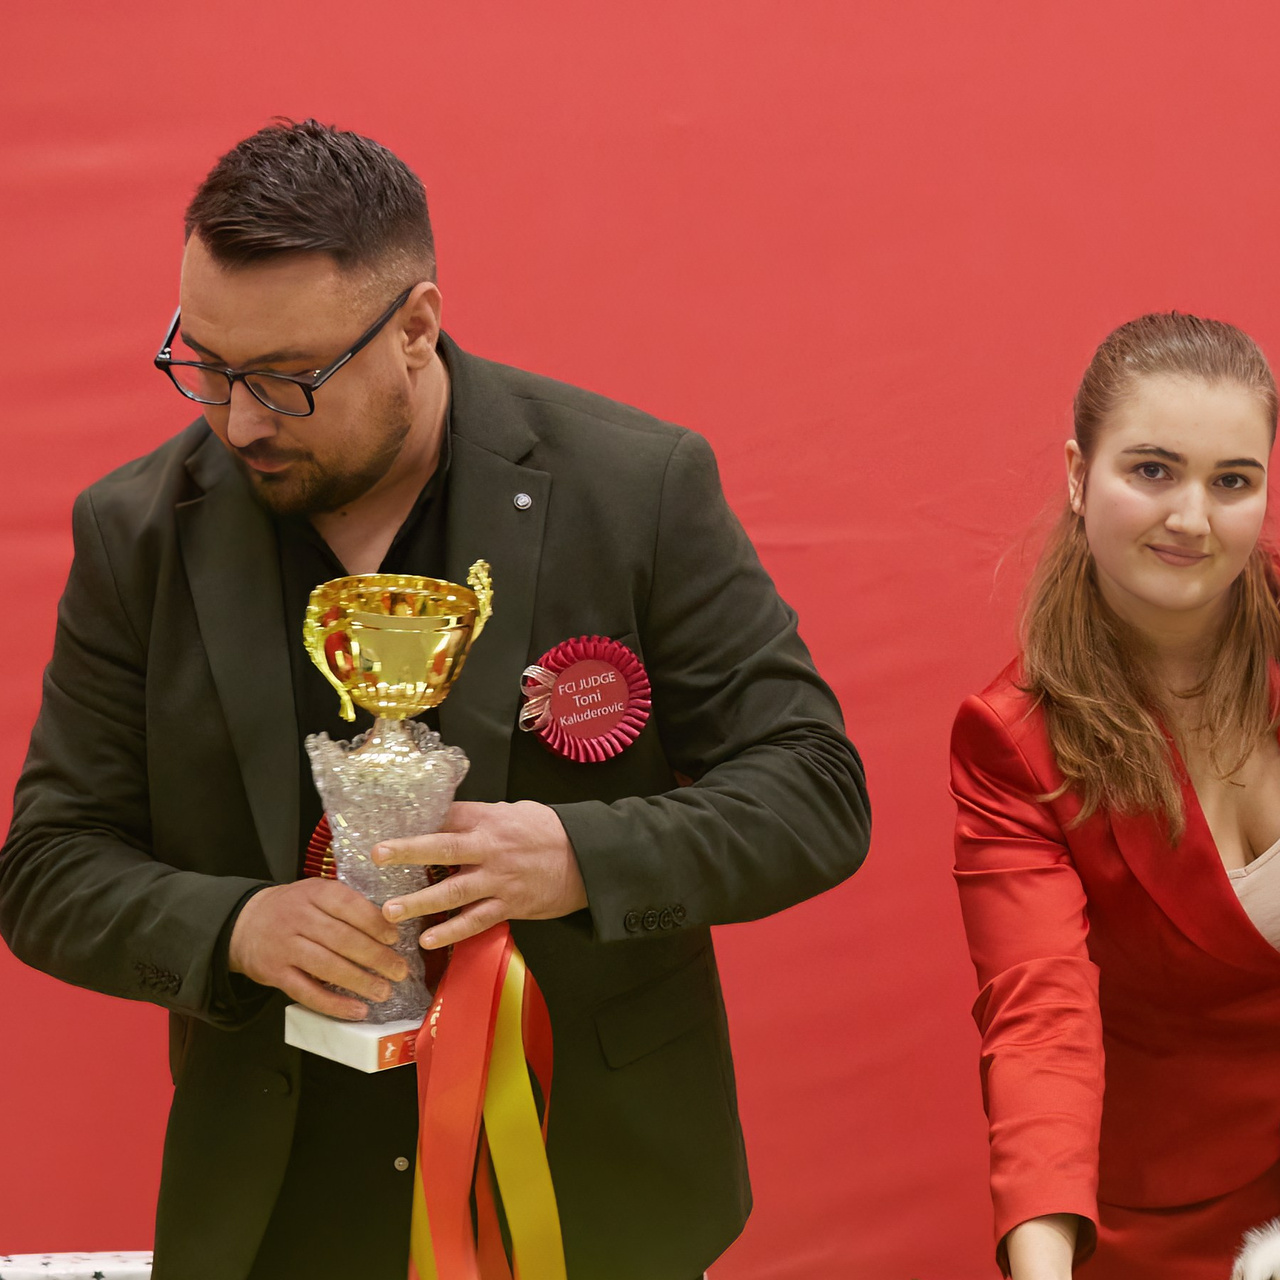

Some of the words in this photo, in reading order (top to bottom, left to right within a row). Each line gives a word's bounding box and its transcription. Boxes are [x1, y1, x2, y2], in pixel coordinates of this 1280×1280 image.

[558, 682, 577, 696] FCI
[578, 671, 617, 690] JUDGE
[572, 689, 602, 708] Toni
[559, 701, 625, 727] Kaluderovic
